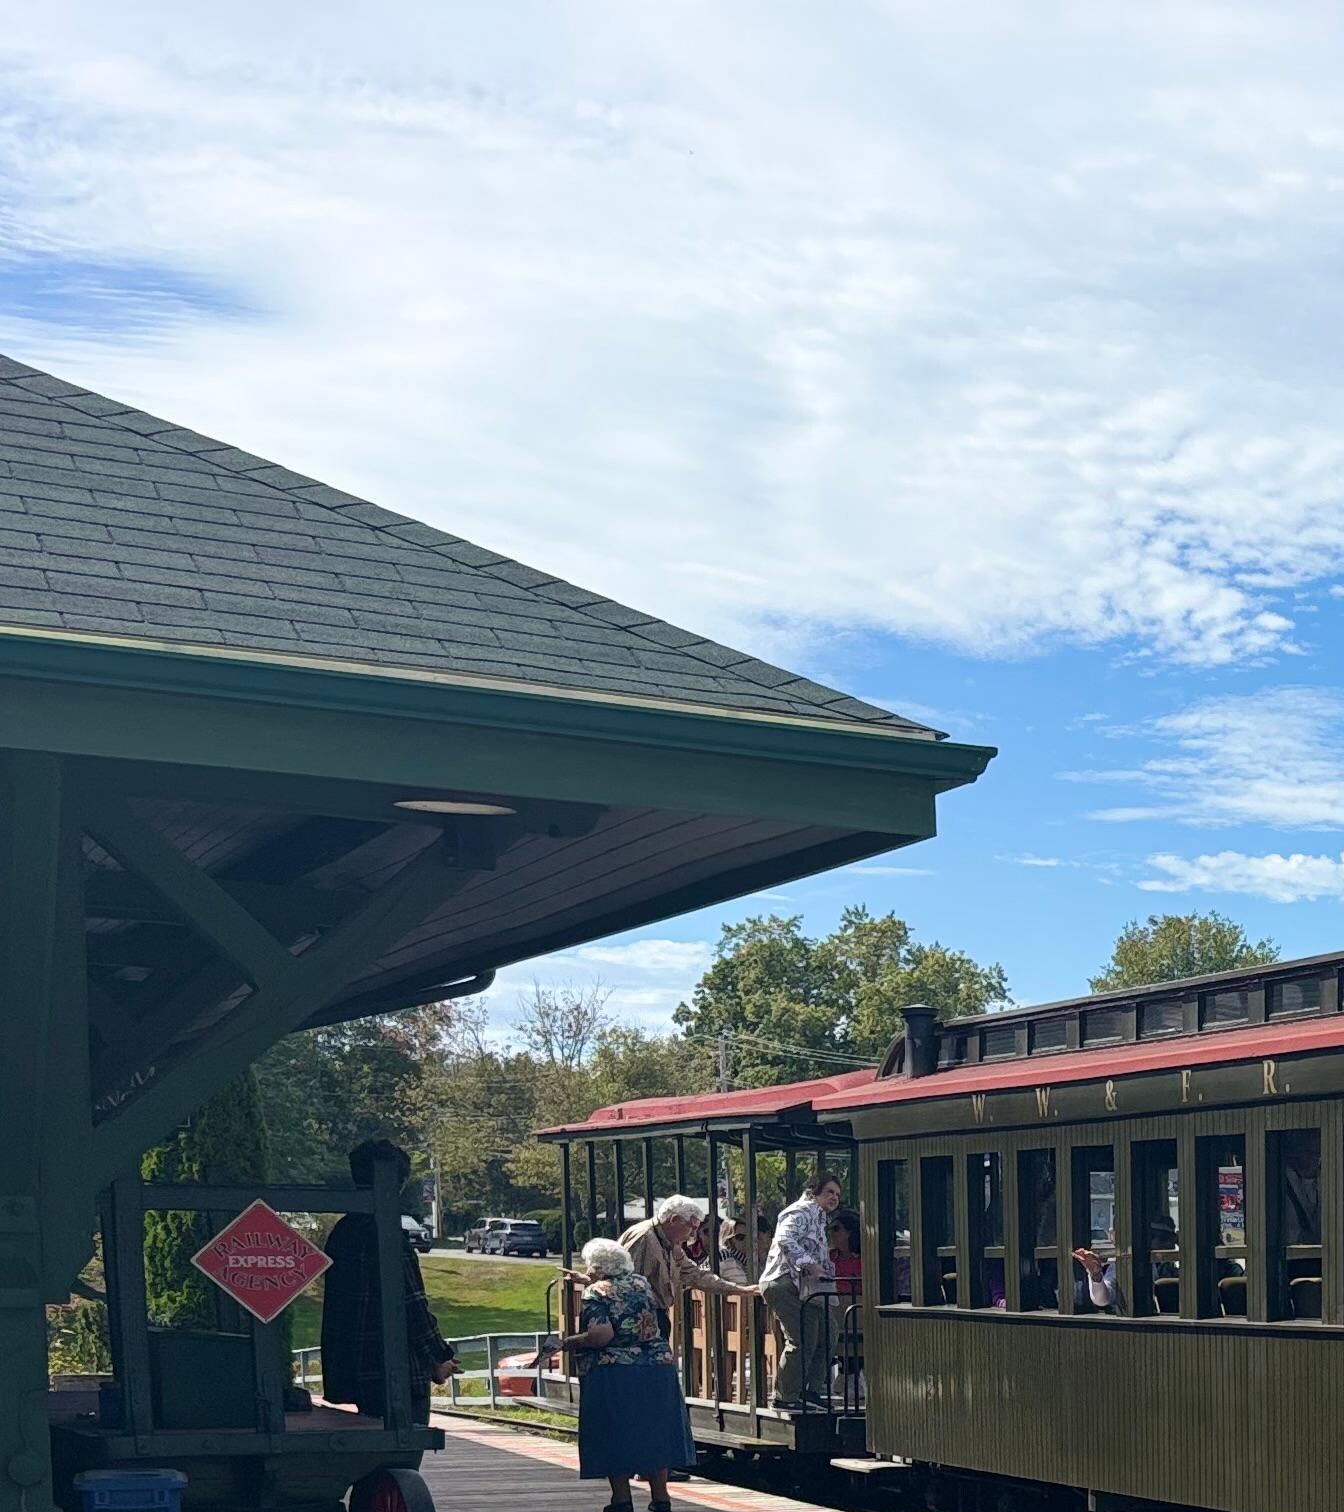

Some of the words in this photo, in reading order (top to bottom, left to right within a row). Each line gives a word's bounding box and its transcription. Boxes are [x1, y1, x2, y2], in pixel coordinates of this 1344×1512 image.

[971, 1094, 994, 1124] W.
[1035, 1087, 1059, 1118] W.
[1105, 1079, 1119, 1112] &
[1180, 1070, 1203, 1103] F.
[1262, 1060, 1291, 1096] R.
[212, 1231, 319, 1260] RAILWAY
[228, 1255, 296, 1268] EXPRESS
[214, 1263, 309, 1291] AGENCY
